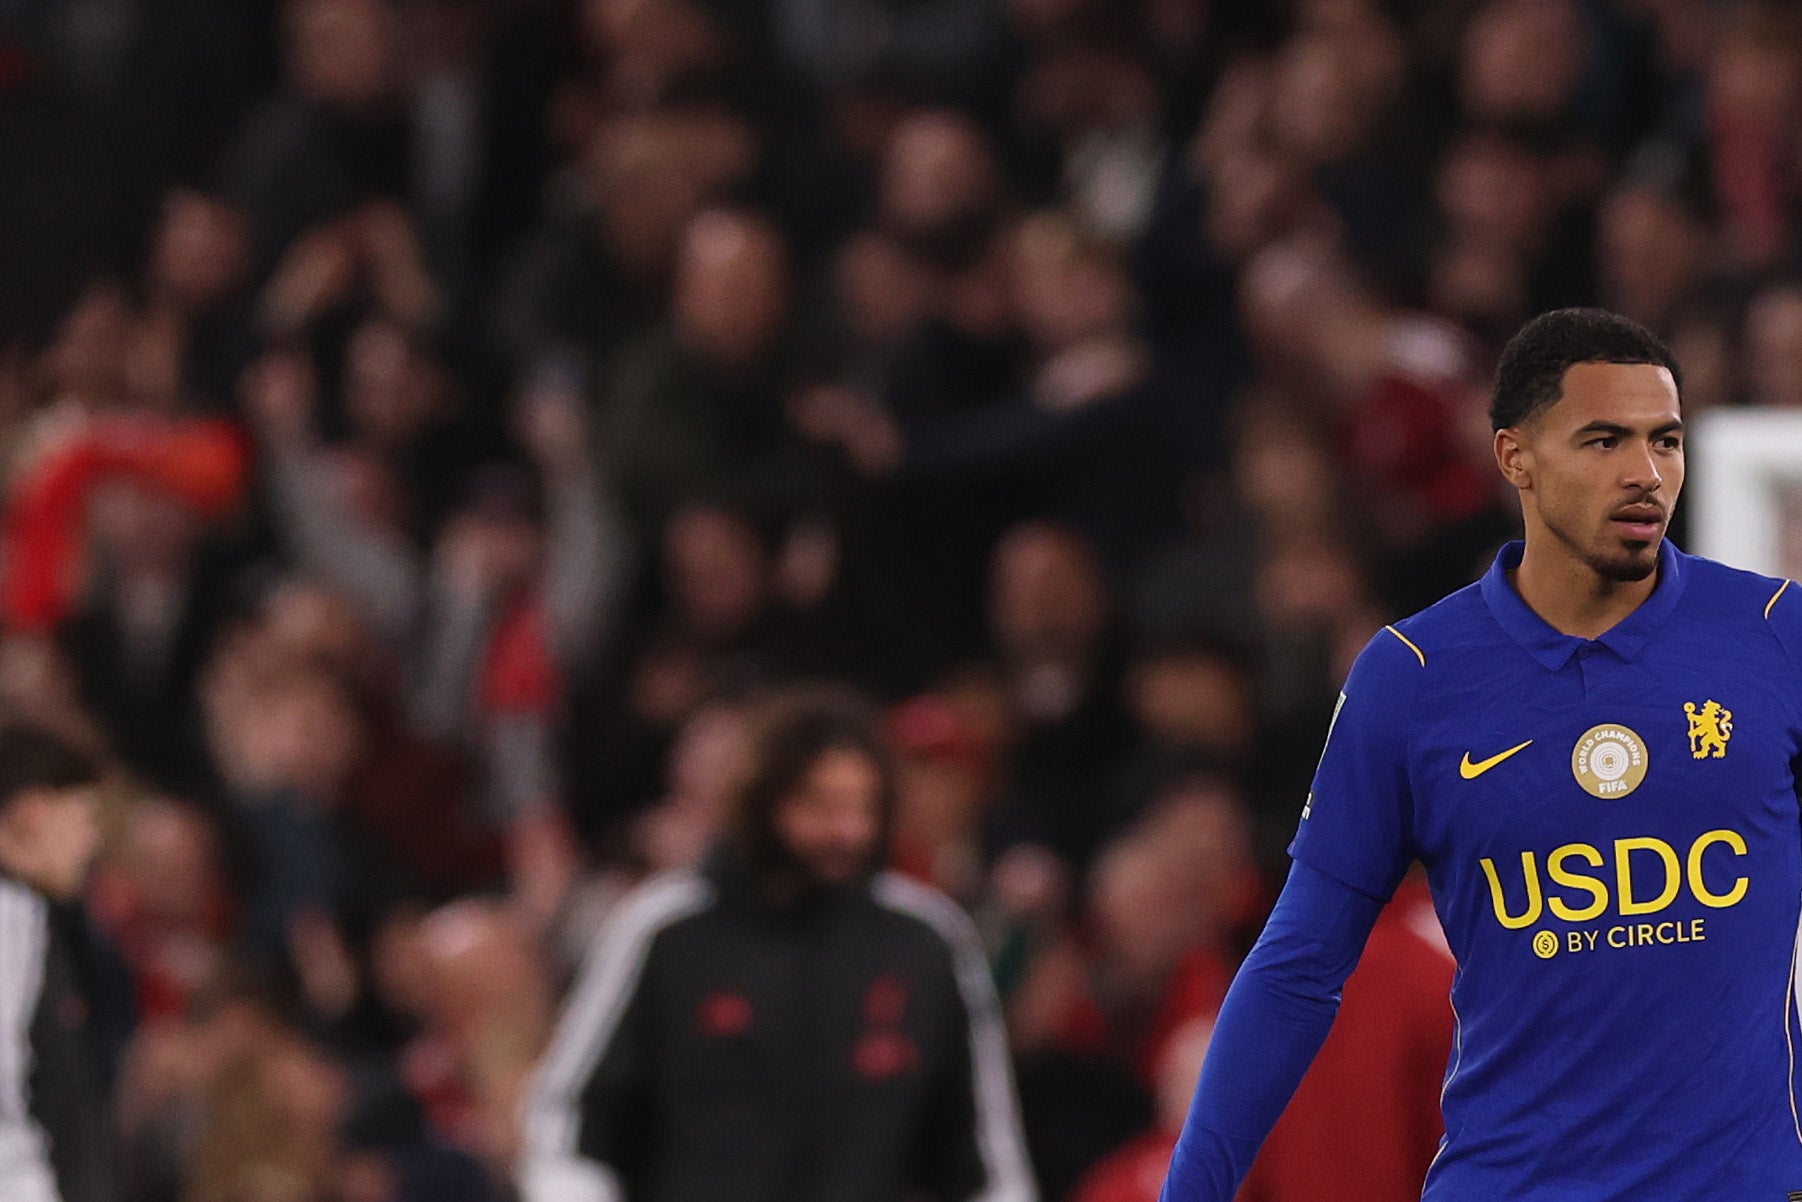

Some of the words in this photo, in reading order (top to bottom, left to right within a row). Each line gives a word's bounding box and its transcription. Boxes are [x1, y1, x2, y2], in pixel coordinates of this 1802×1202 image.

[1578, 739, 1594, 775] WORLD
[1595, 730, 1641, 766] CHAMPIONS
[1598, 780, 1628, 794] FIFA
[1480, 829, 1749, 930] USDC
[1567, 930, 1599, 953] BY
[1607, 919, 1706, 948] CIRCLE
